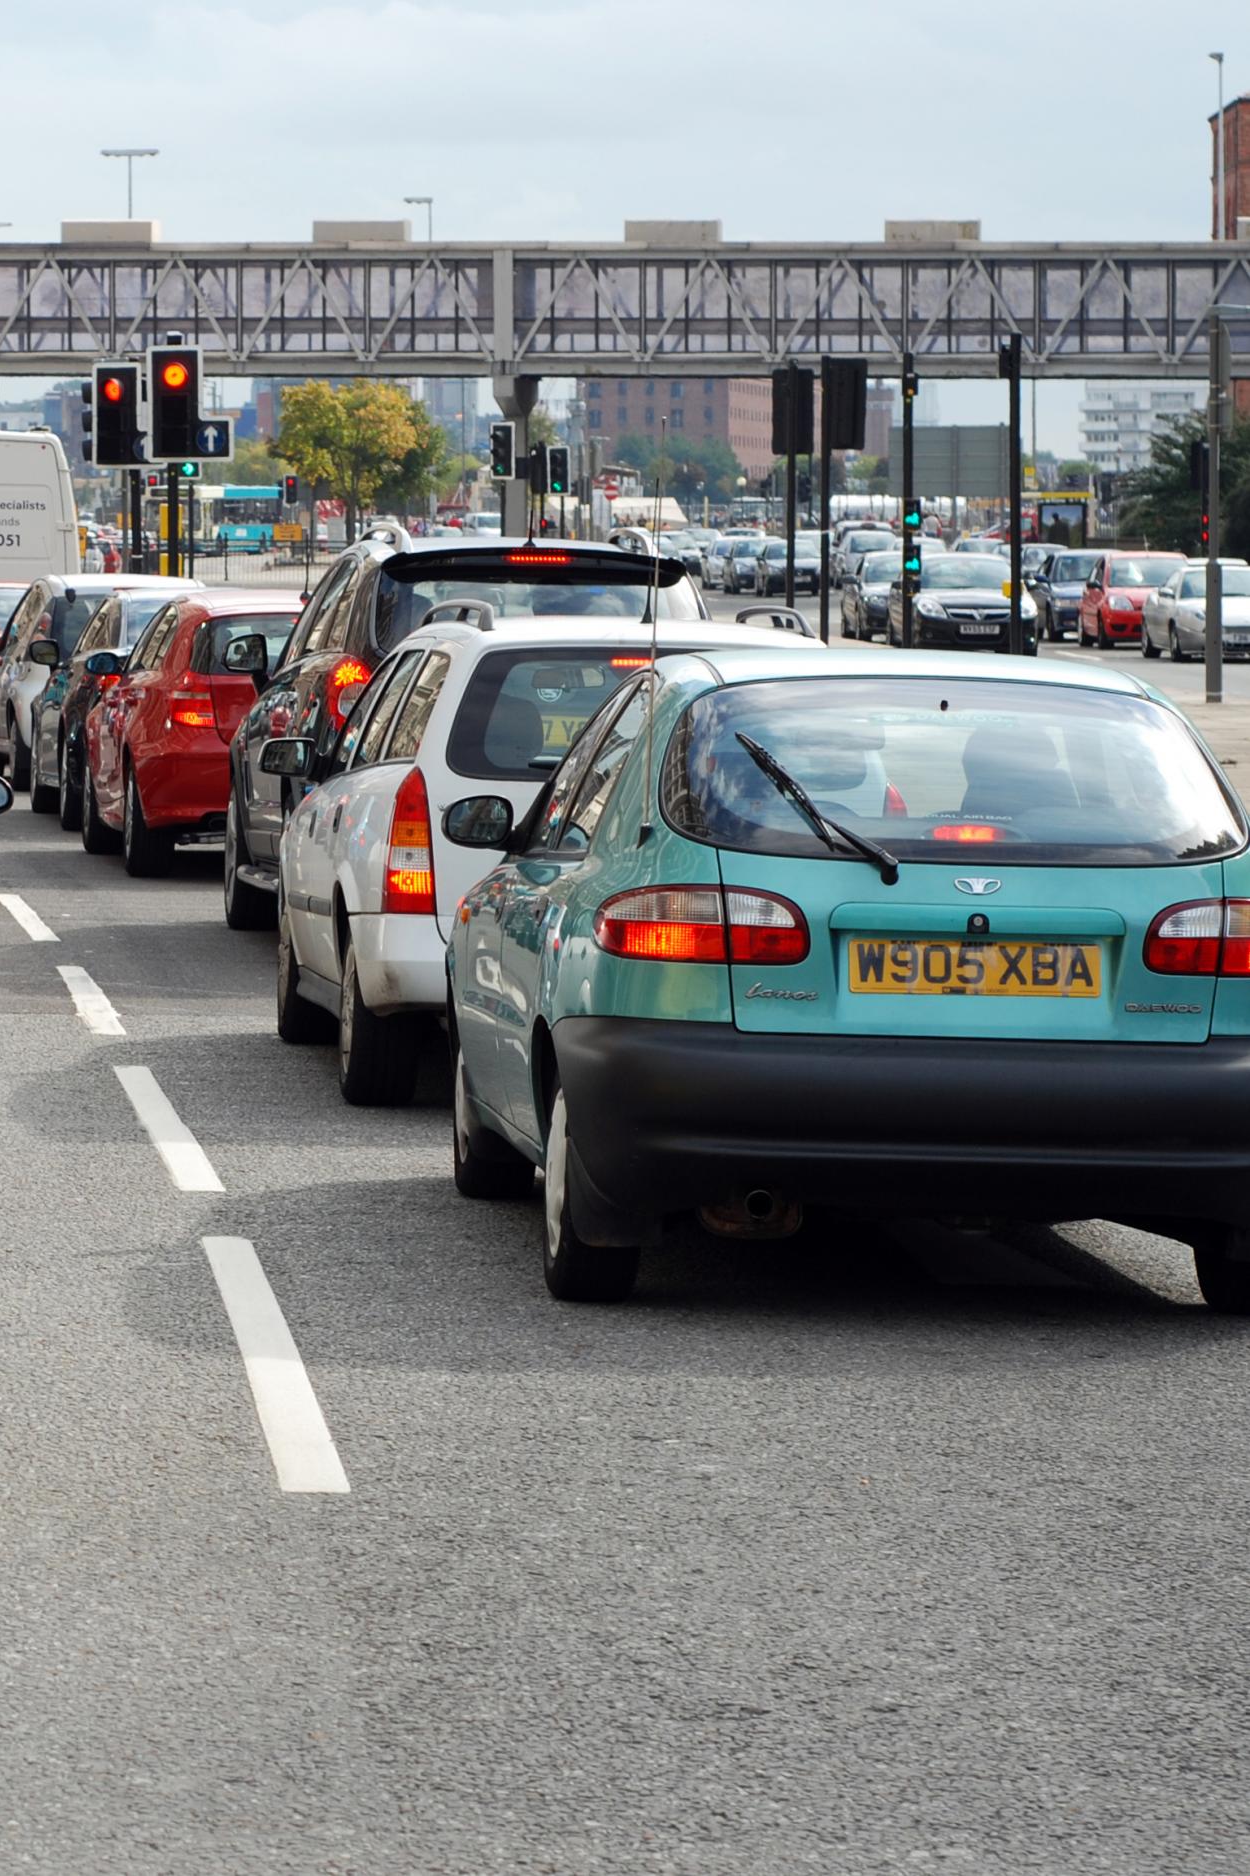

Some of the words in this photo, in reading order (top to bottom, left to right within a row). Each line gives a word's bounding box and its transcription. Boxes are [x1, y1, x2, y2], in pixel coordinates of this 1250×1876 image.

[856, 942, 986, 985] W905
[998, 945, 1094, 988] XBA
[744, 981, 819, 1001] Lanos
[1125, 1002, 1203, 1014] DAEWOO
